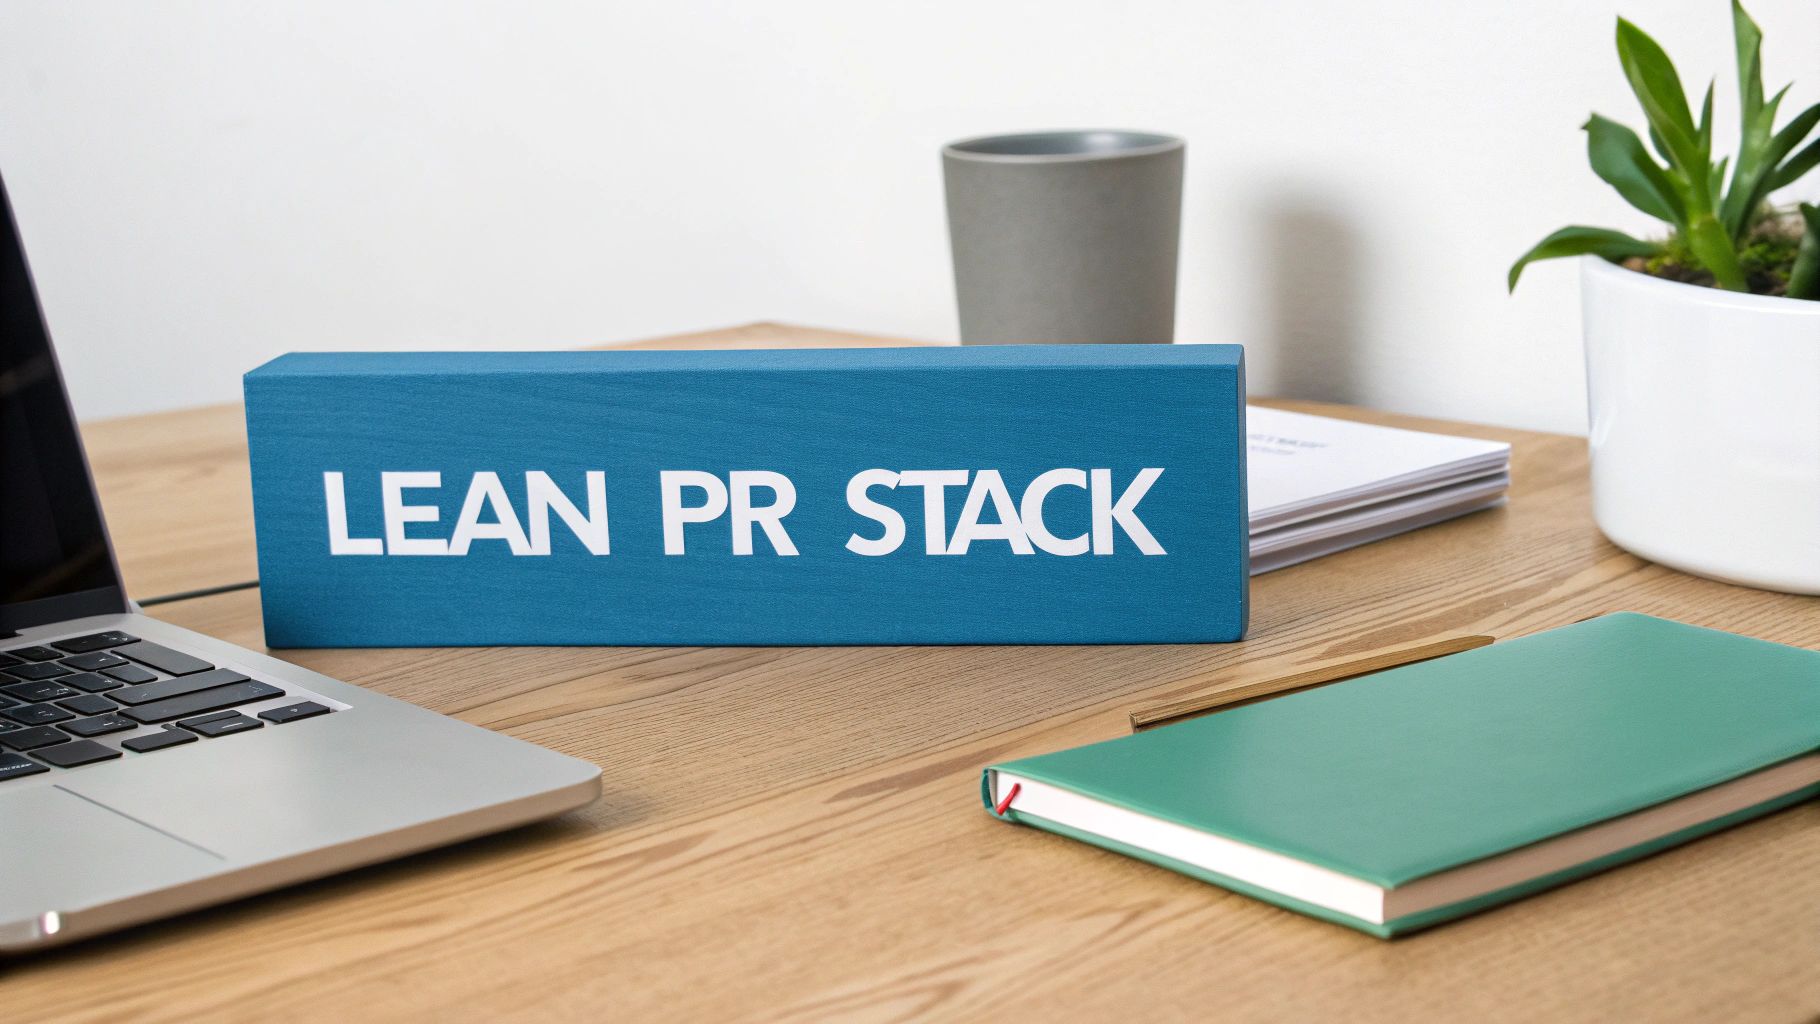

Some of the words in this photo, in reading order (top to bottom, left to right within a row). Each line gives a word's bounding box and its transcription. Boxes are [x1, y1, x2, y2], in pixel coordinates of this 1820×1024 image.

[323, 470, 610, 557] LEAN
[660, 470, 800, 557] PR
[845, 467, 1168, 557] STACK
